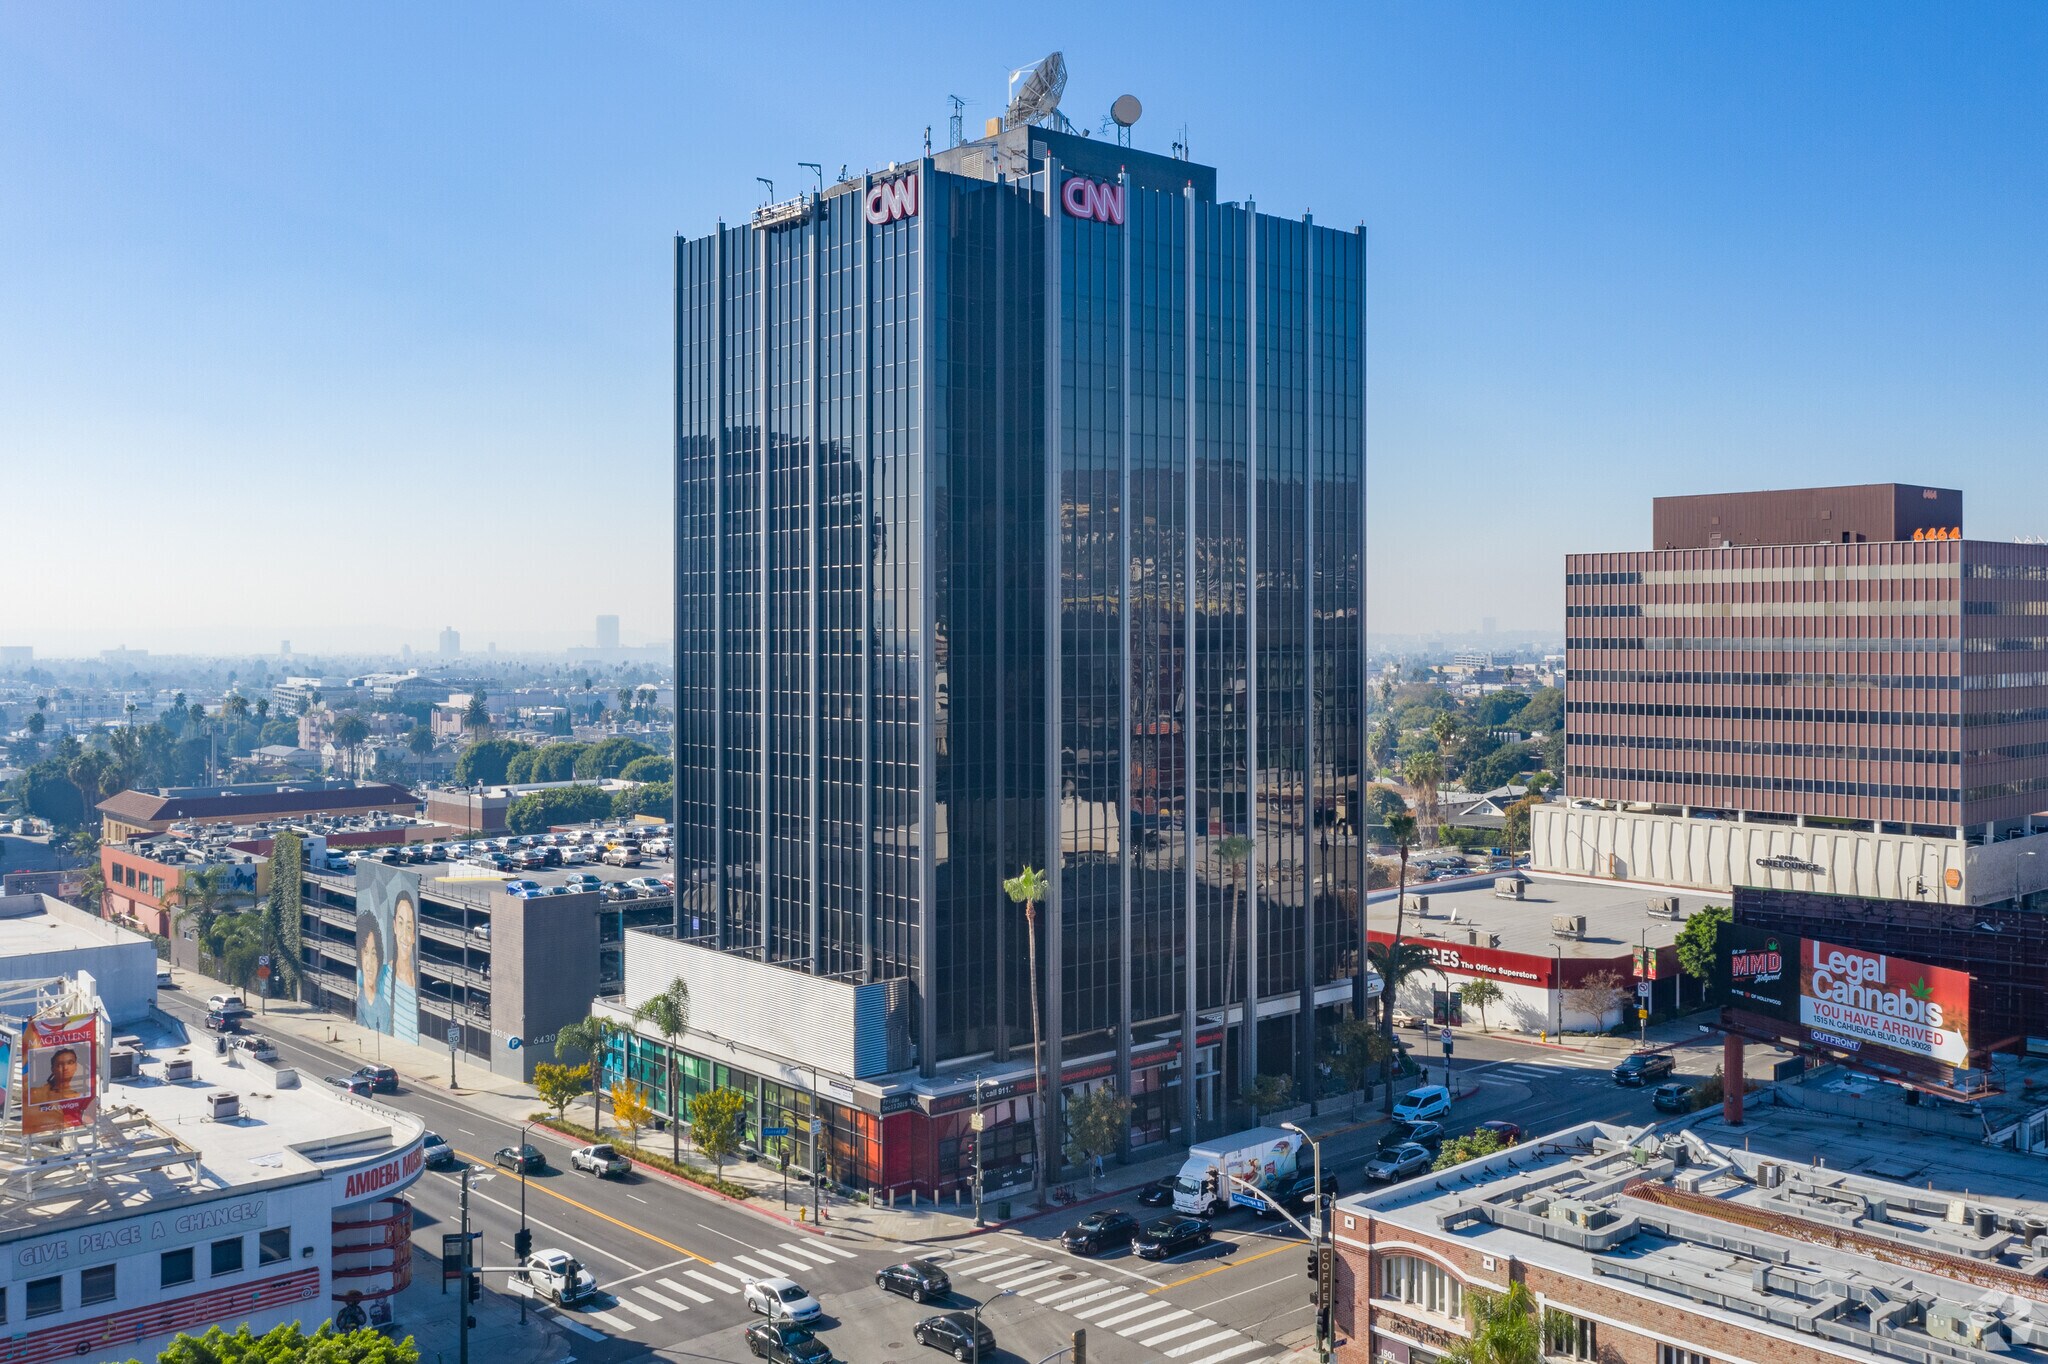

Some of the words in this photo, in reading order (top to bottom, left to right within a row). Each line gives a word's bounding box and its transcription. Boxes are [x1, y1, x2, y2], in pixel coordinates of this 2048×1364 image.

[866, 174, 918, 225] CNN
[1062, 177, 1124, 225] CNN
[1914, 526, 1960, 541] 6464
[1756, 858, 1819, 872] CINELOUNGE
[1460, 962, 1474, 970] The
[1476, 964, 1496, 973] Office
[1498, 967, 1538, 980] Superstore
[1732, 952, 1782, 976] MMD
[1813, 940, 1886, 986] Legal
[1812, 970, 1944, 1028] Cannabis
[1814, 1002, 1840, 1019] YOU
[1844, 1009, 1878, 1030] HAVE
[1882, 1020, 1943, 1046] ARRIVED
[1814, 1015, 1828, 1025] 1515
[1829, 1018, 1836, 1027] N.
[1836, 1020, 1876, 1038] CAHUENGA
[1877, 1031, 1898, 1044] BLVD.
[1899, 1037, 1910, 1046] CA
[1911, 1040, 1932, 1052] 90028
[28, 1030, 91, 1047] MAGDALENE
[512, 1039, 518, 1048] P
[533, 1034, 556, 1044] 6430
[1813, 1032, 1858, 1050] OUTFRONT
[58, 1102, 79, 1110] twigs
[345, 1160, 399, 1198] AMOEBA
[18, 1240, 69, 1266] GIVE
[78, 1226, 141, 1254] PEACE
[152, 1221, 166, 1239] A
[175, 1200, 264, 1234] CHANCE!
[1381, 1349, 1395, 1360] 1501
